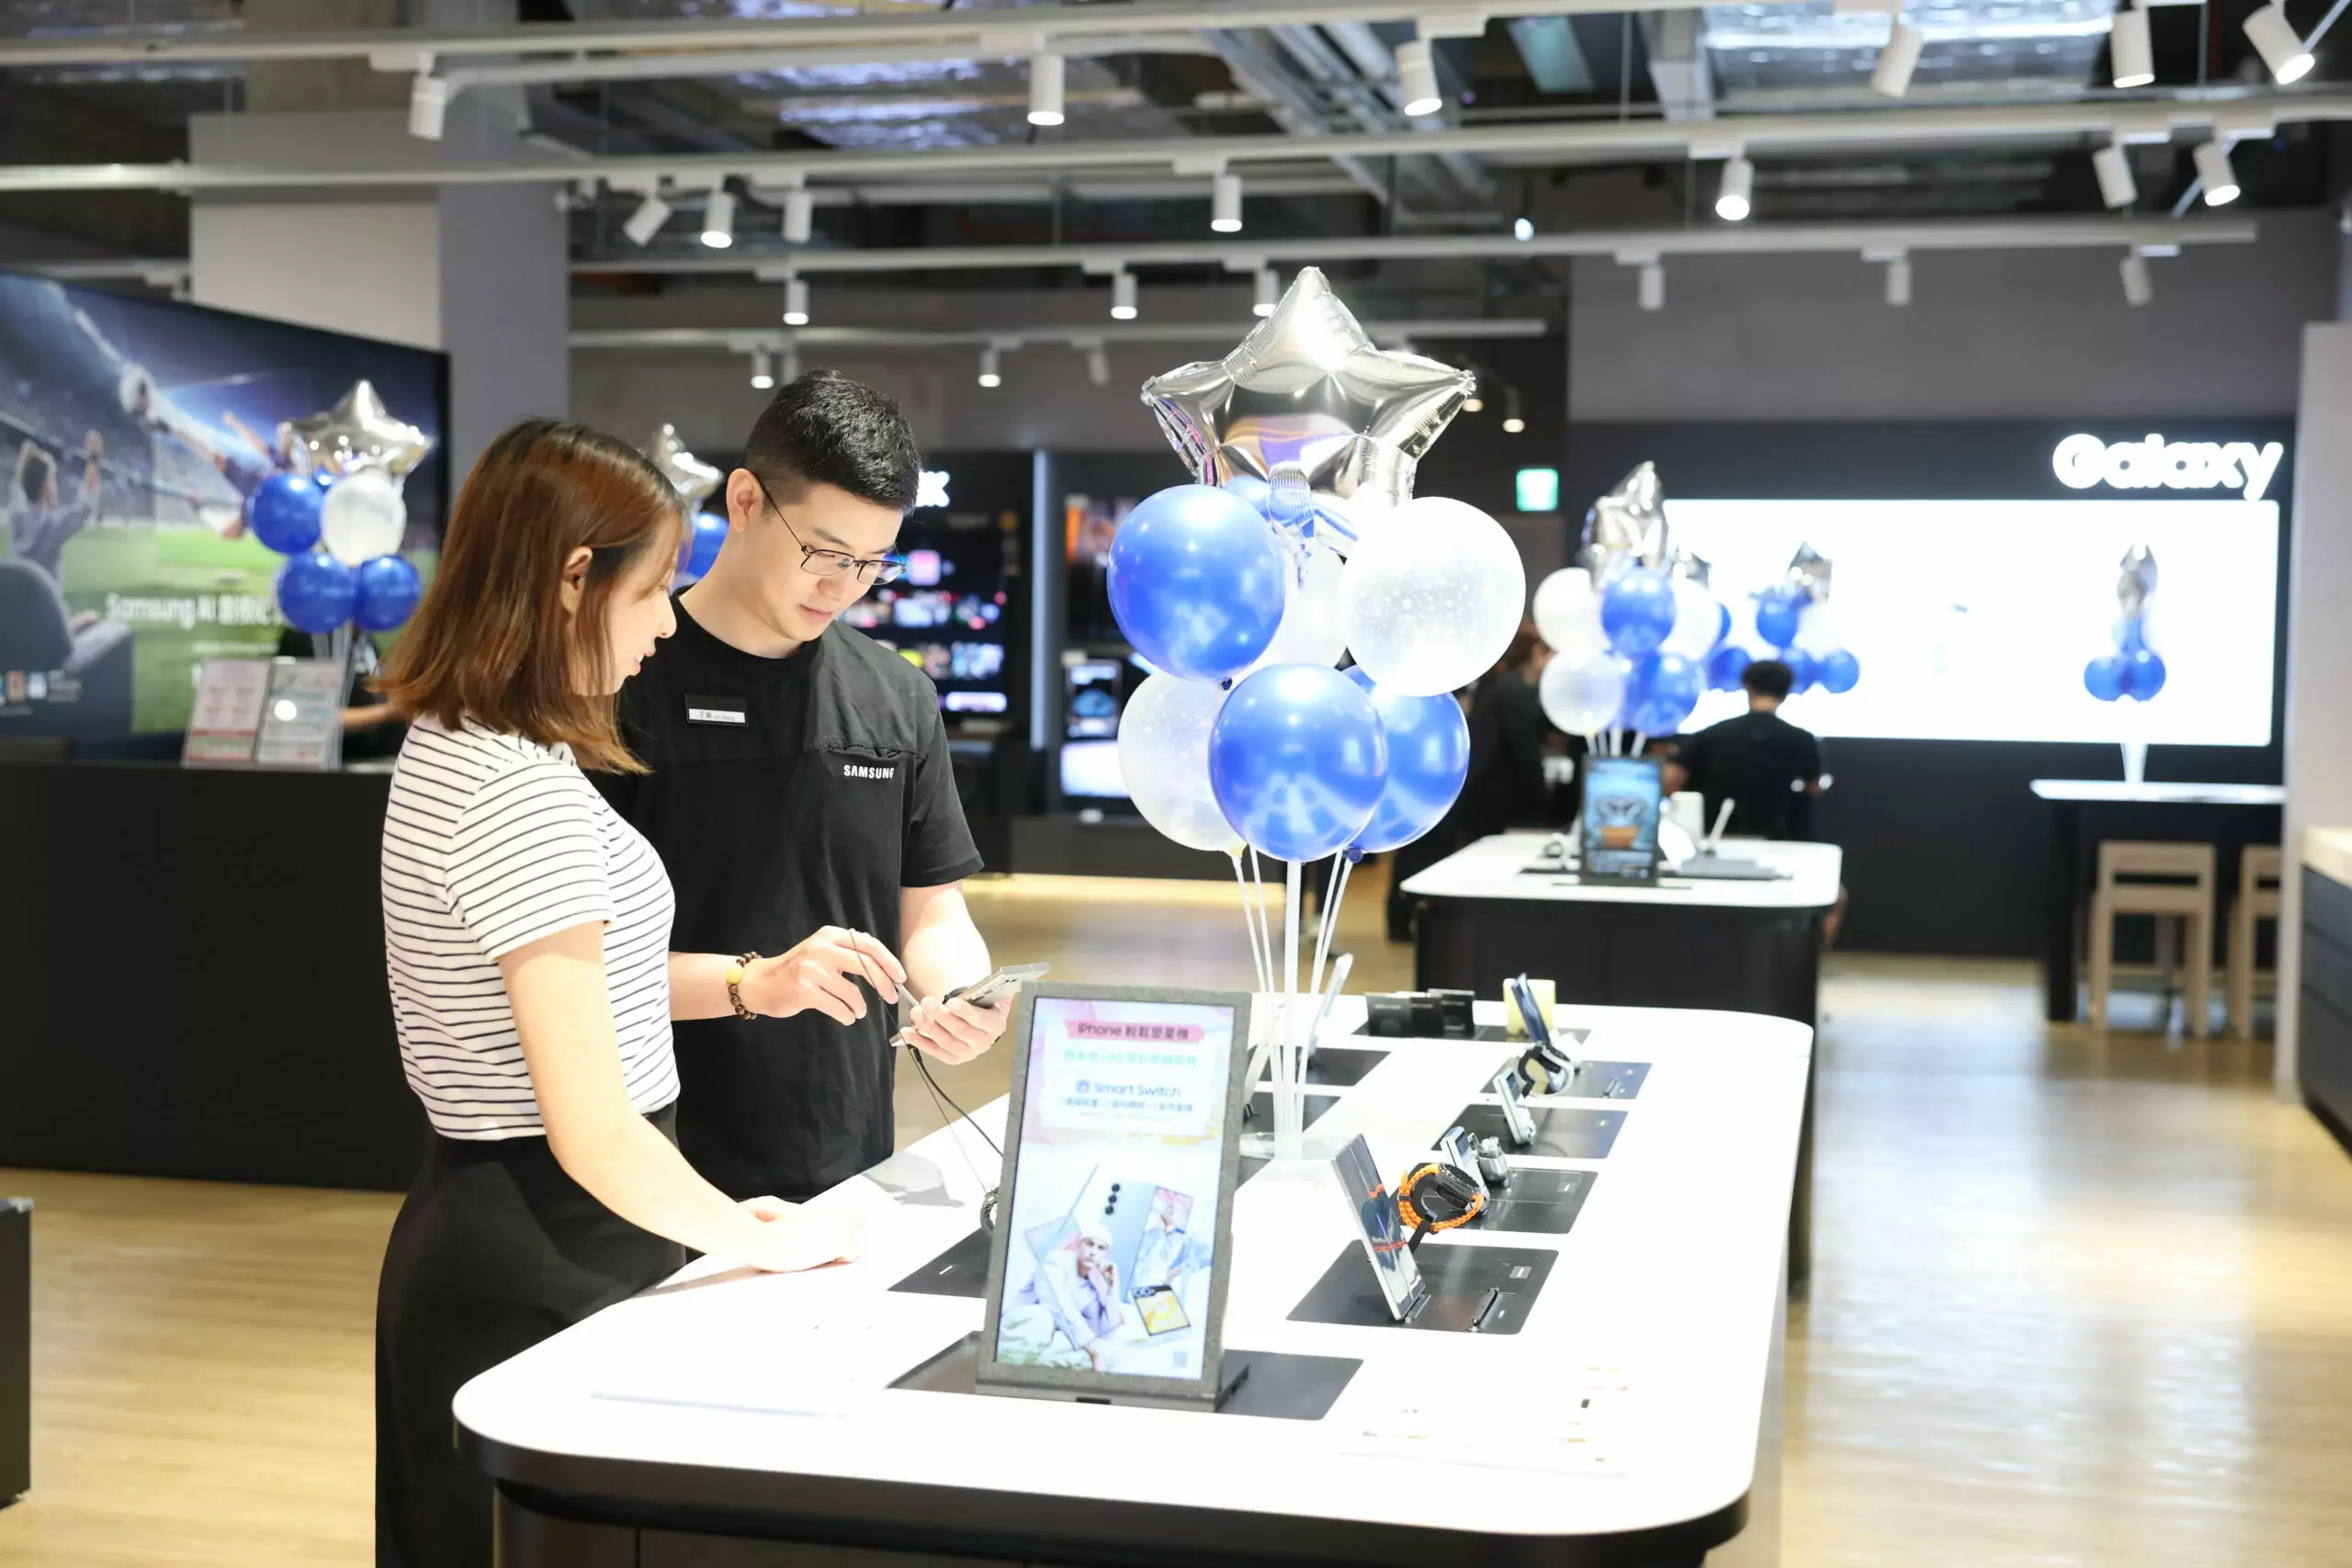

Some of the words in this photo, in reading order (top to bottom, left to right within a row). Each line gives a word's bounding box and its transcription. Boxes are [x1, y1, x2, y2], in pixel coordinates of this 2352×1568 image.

[2052, 434, 2283, 501] Galaxy
[843, 764, 895, 779] SAMSUNG
[1077, 1022, 1122, 1037] iPhone
[1093, 1082, 1134, 1096] Smart
[1137, 1084, 1182, 1097] Switch
